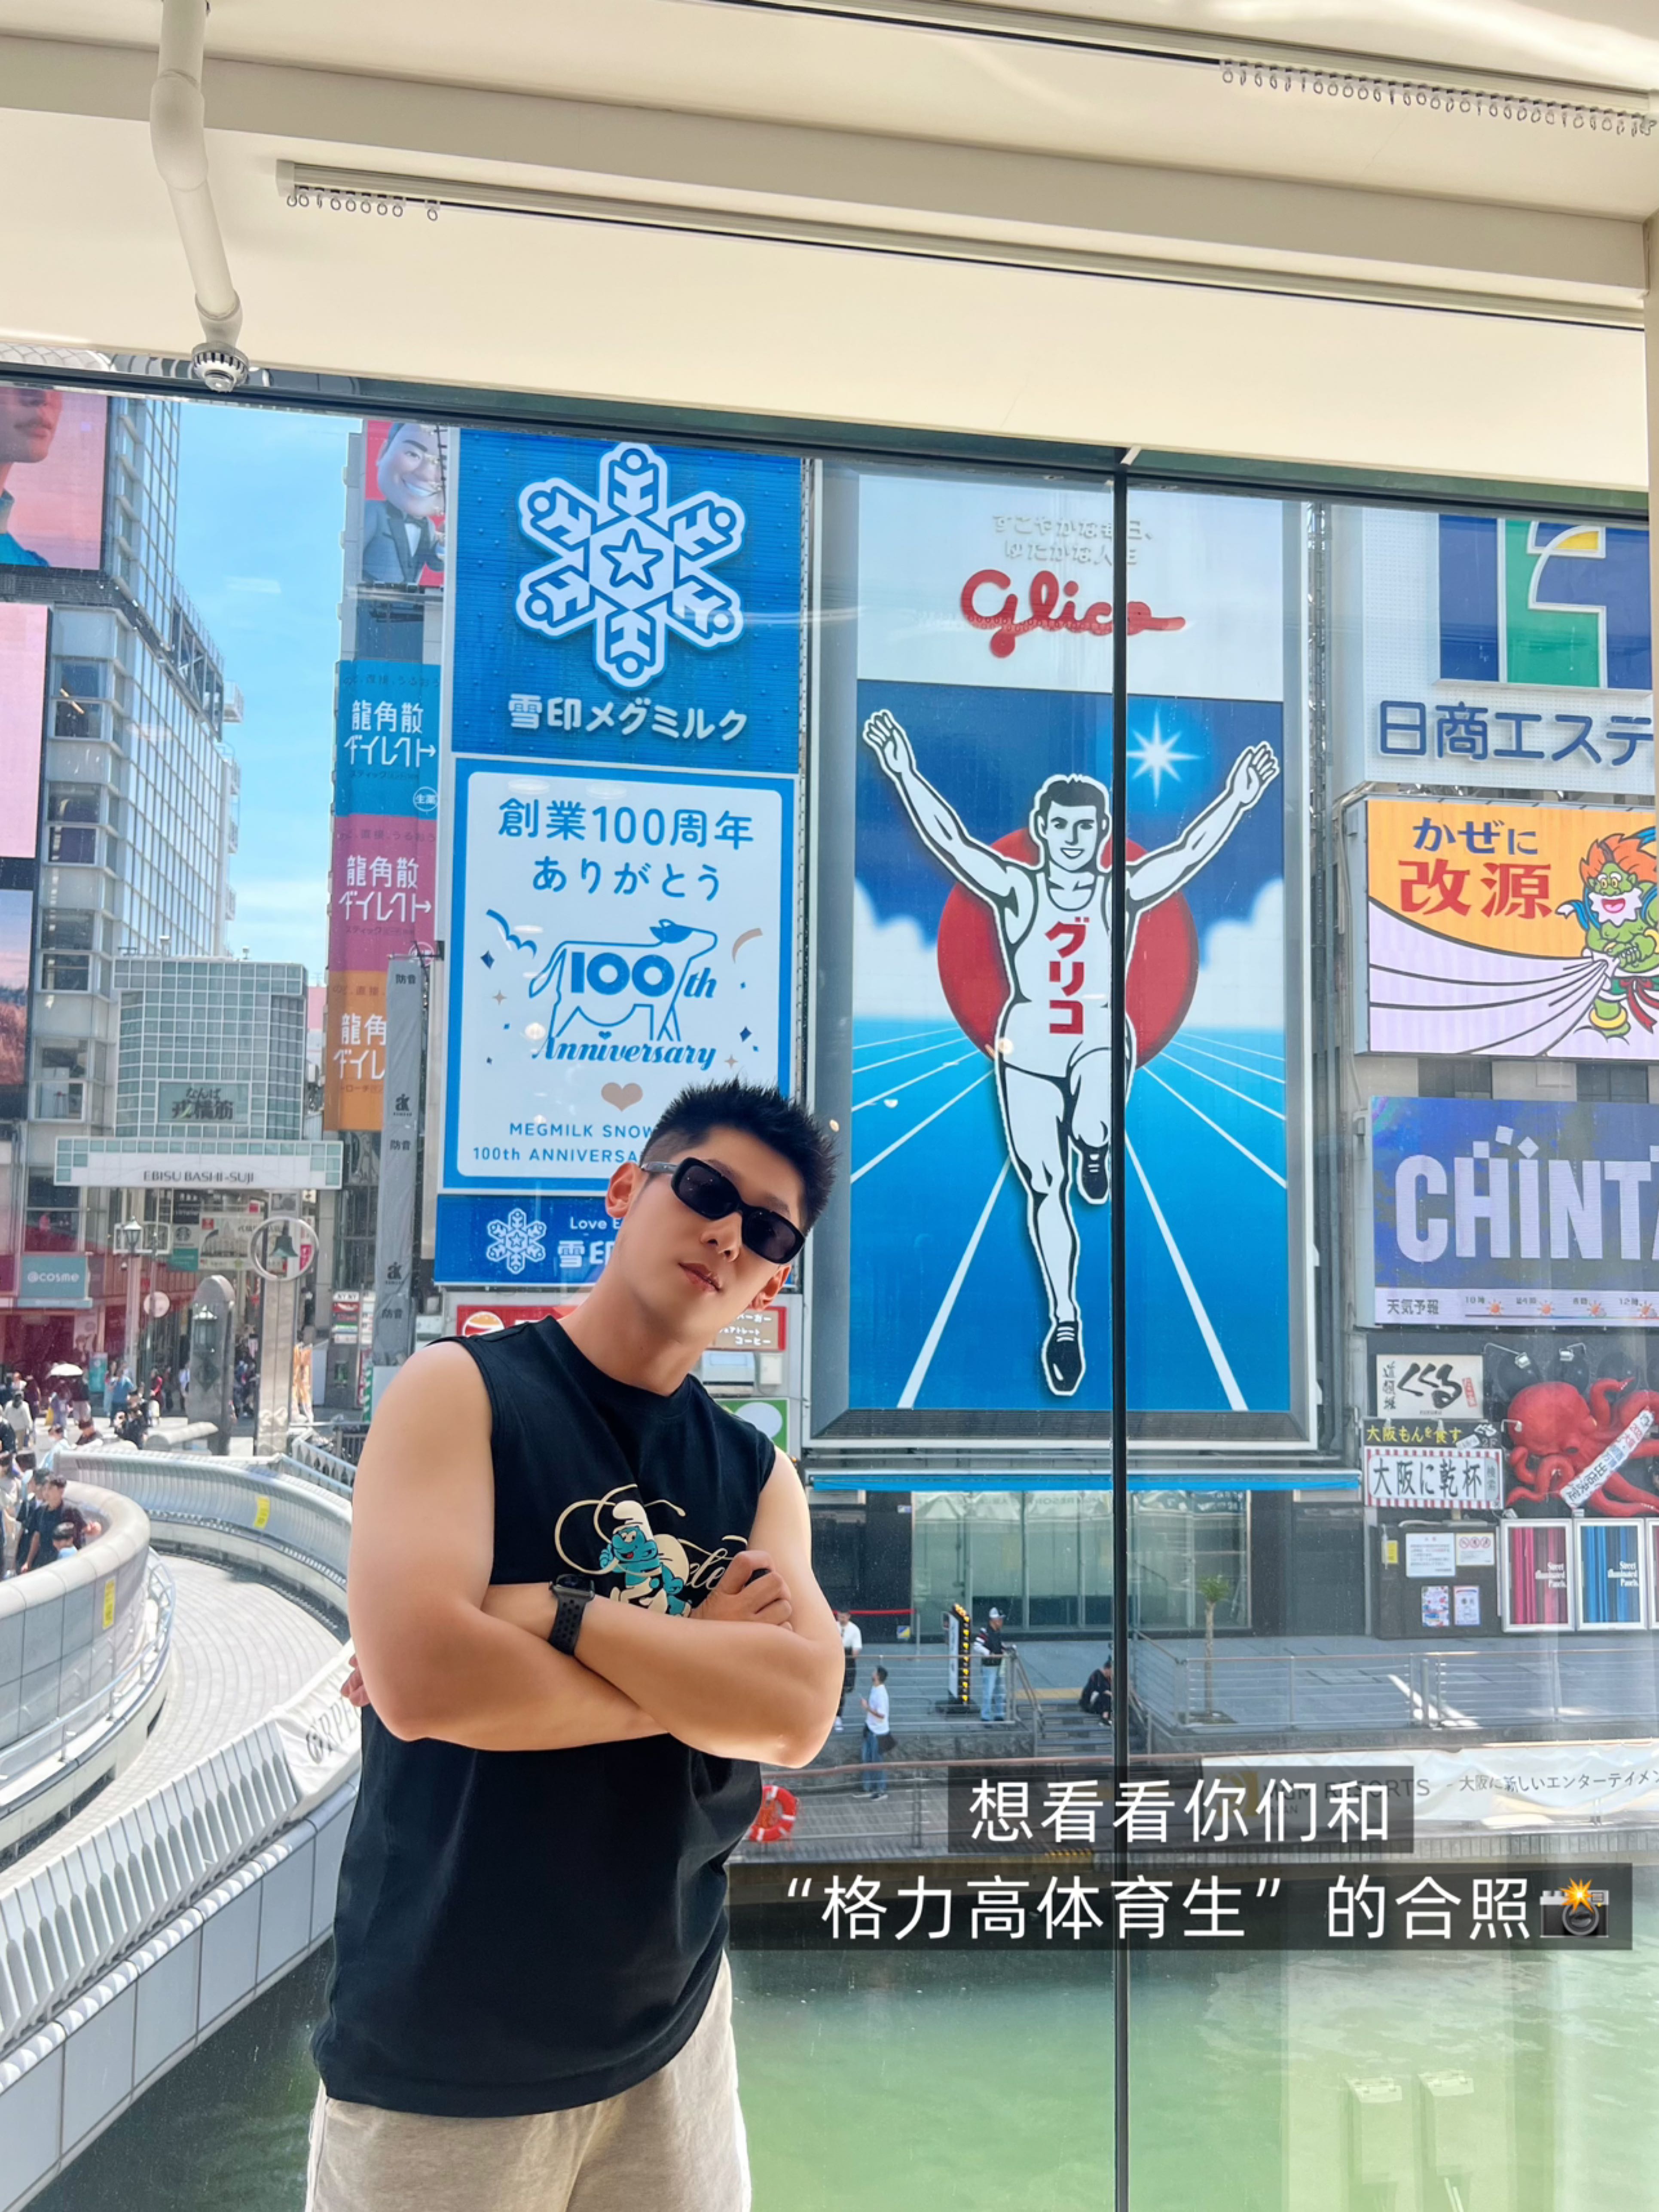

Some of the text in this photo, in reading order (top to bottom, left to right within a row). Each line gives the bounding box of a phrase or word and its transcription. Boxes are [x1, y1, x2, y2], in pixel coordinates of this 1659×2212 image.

[961, 569, 1185, 657] Glico
[352, 700, 424, 734] 龍角散
[508, 693, 748, 741] 雪印メグミルク
[1379, 700, 1654, 766] 日商エステ
[498, 797, 755, 851] 創業100周年
[1412, 817, 1539, 855] かぜに
[347, 855, 419, 889] 龍角散
[532, 855, 720, 902] ありがとう
[1398, 858, 1552, 919] 改源
[571, 951, 717, 998] 100th
[1045, 916, 1091, 1035] グリコ
[532, 1034, 717, 1071] Anniversary
[509, 1123, 593, 1138] MEGMILK
[474, 1147, 520, 1161] 100th
[144, 1170, 181, 1182] EBISU
[1395, 1139, 1659, 1262] CHINT
[570, 1216, 607, 1230] Love
[27, 1271, 79, 1283] @cosme
[1387, 1299, 1439, 1314] 天気予報
[735, 1336, 771, 1345] コーヒー
[1396, 1362, 1462, 1409] くくる
[1373, 1457, 1482, 1498] 大阪に乾杯
